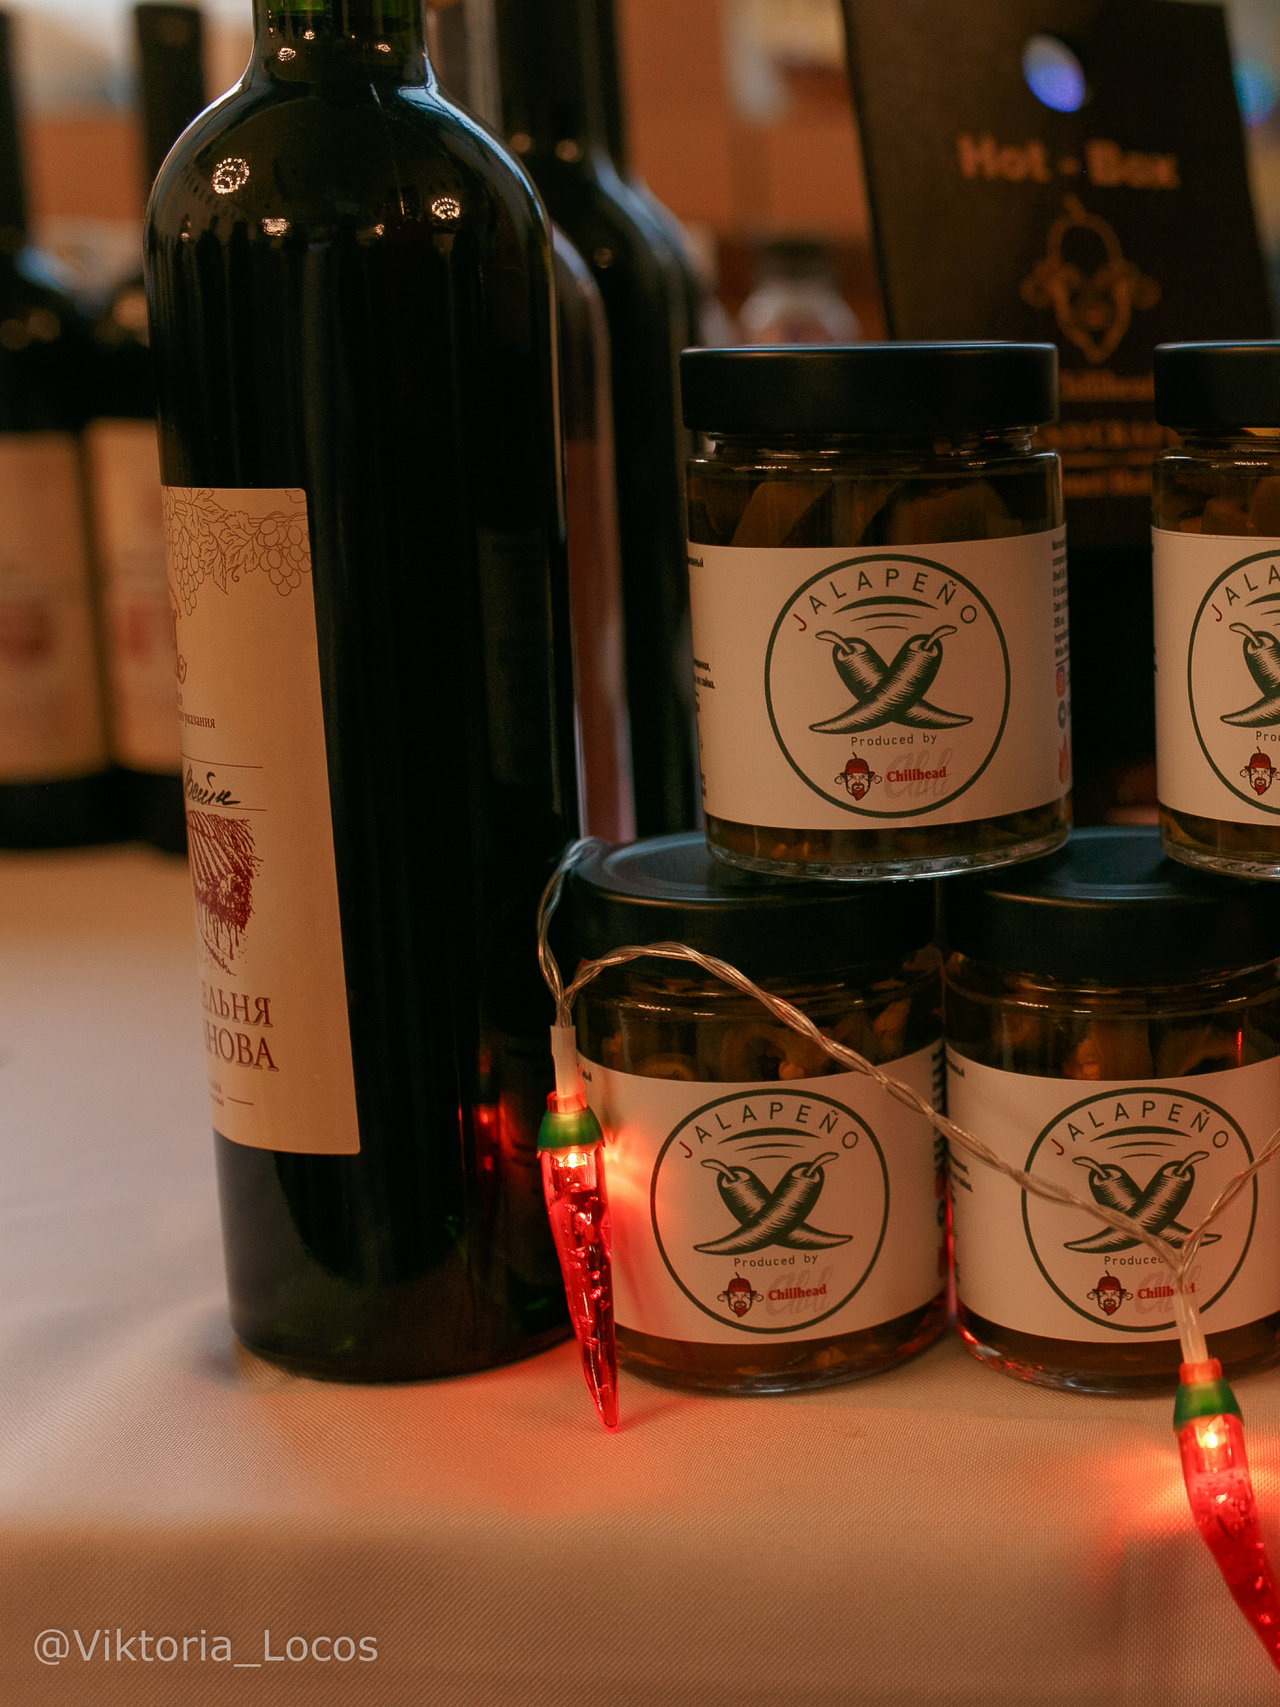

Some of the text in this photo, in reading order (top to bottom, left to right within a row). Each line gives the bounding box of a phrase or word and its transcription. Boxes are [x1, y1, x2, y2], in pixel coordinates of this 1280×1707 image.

[956, 133, 1051, 184] Hot
[793, 568, 977, 632] JALAPEÑO
[851, 732, 938, 747] Produced by
[886, 766, 947, 783] Chilihead
[678, 1101, 859, 1160] JALAPEÑO
[1050, 1100, 1229, 1157] JALAPEÑO
[734, 1254, 818, 1267] Produced by
[768, 1283, 827, 1301] Chilihead
